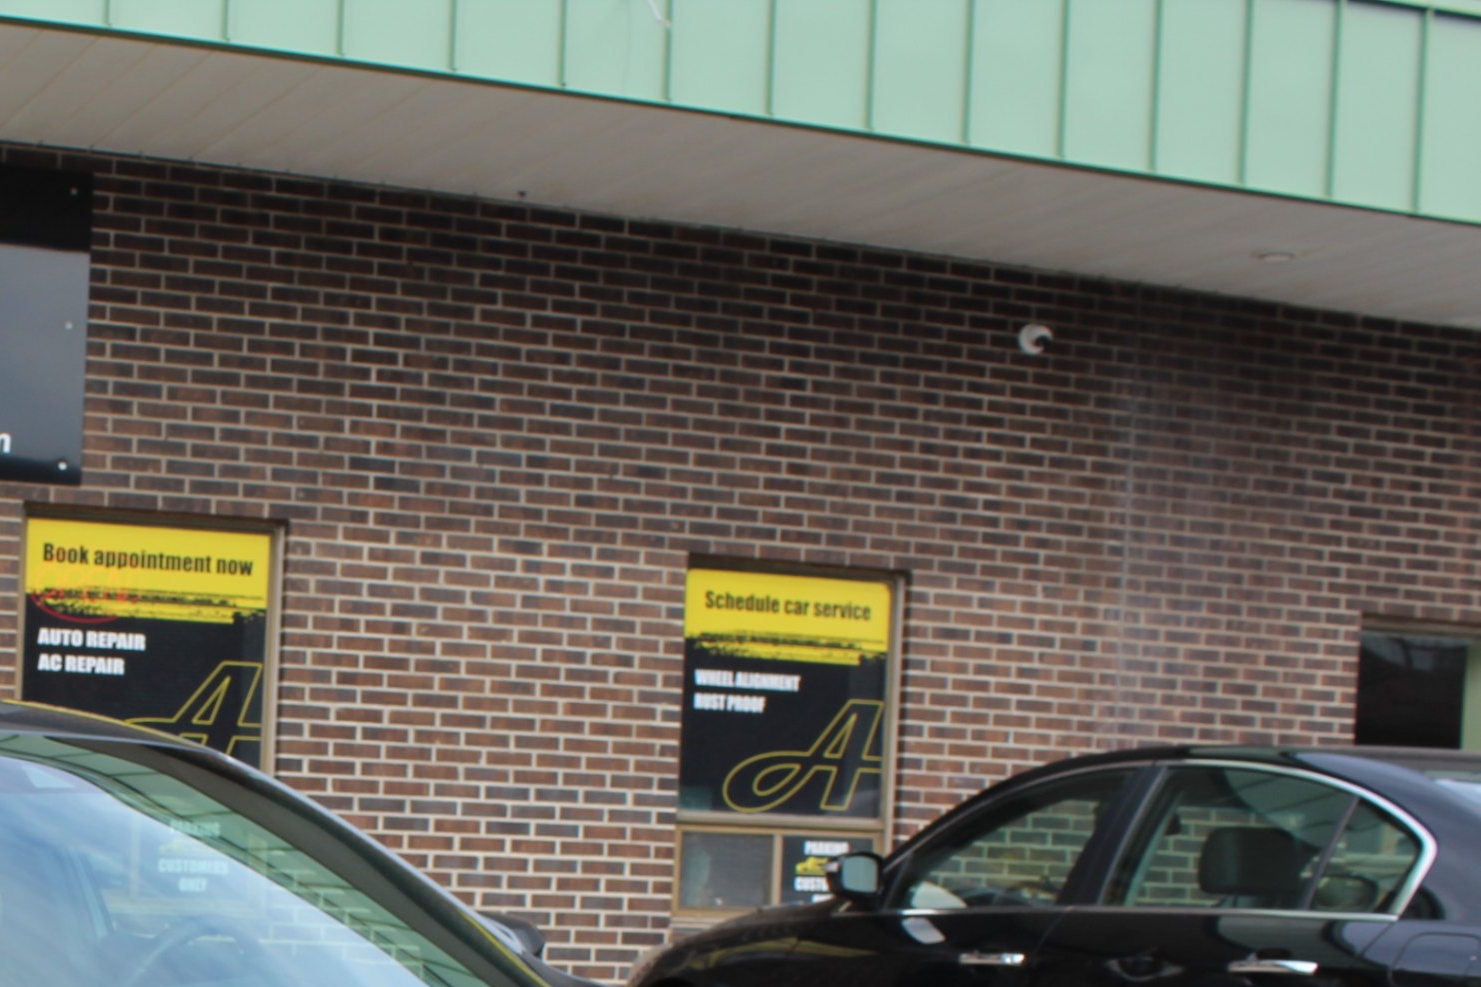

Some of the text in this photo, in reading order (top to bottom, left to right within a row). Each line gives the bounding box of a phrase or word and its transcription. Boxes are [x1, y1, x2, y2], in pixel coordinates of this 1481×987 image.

[42, 542, 254, 577] Book appointment now
[704, 590, 872, 622] Schedule car service
[37, 627, 147, 651] AUTO REPAIR
[37, 653, 125, 676] AC REPAIR
